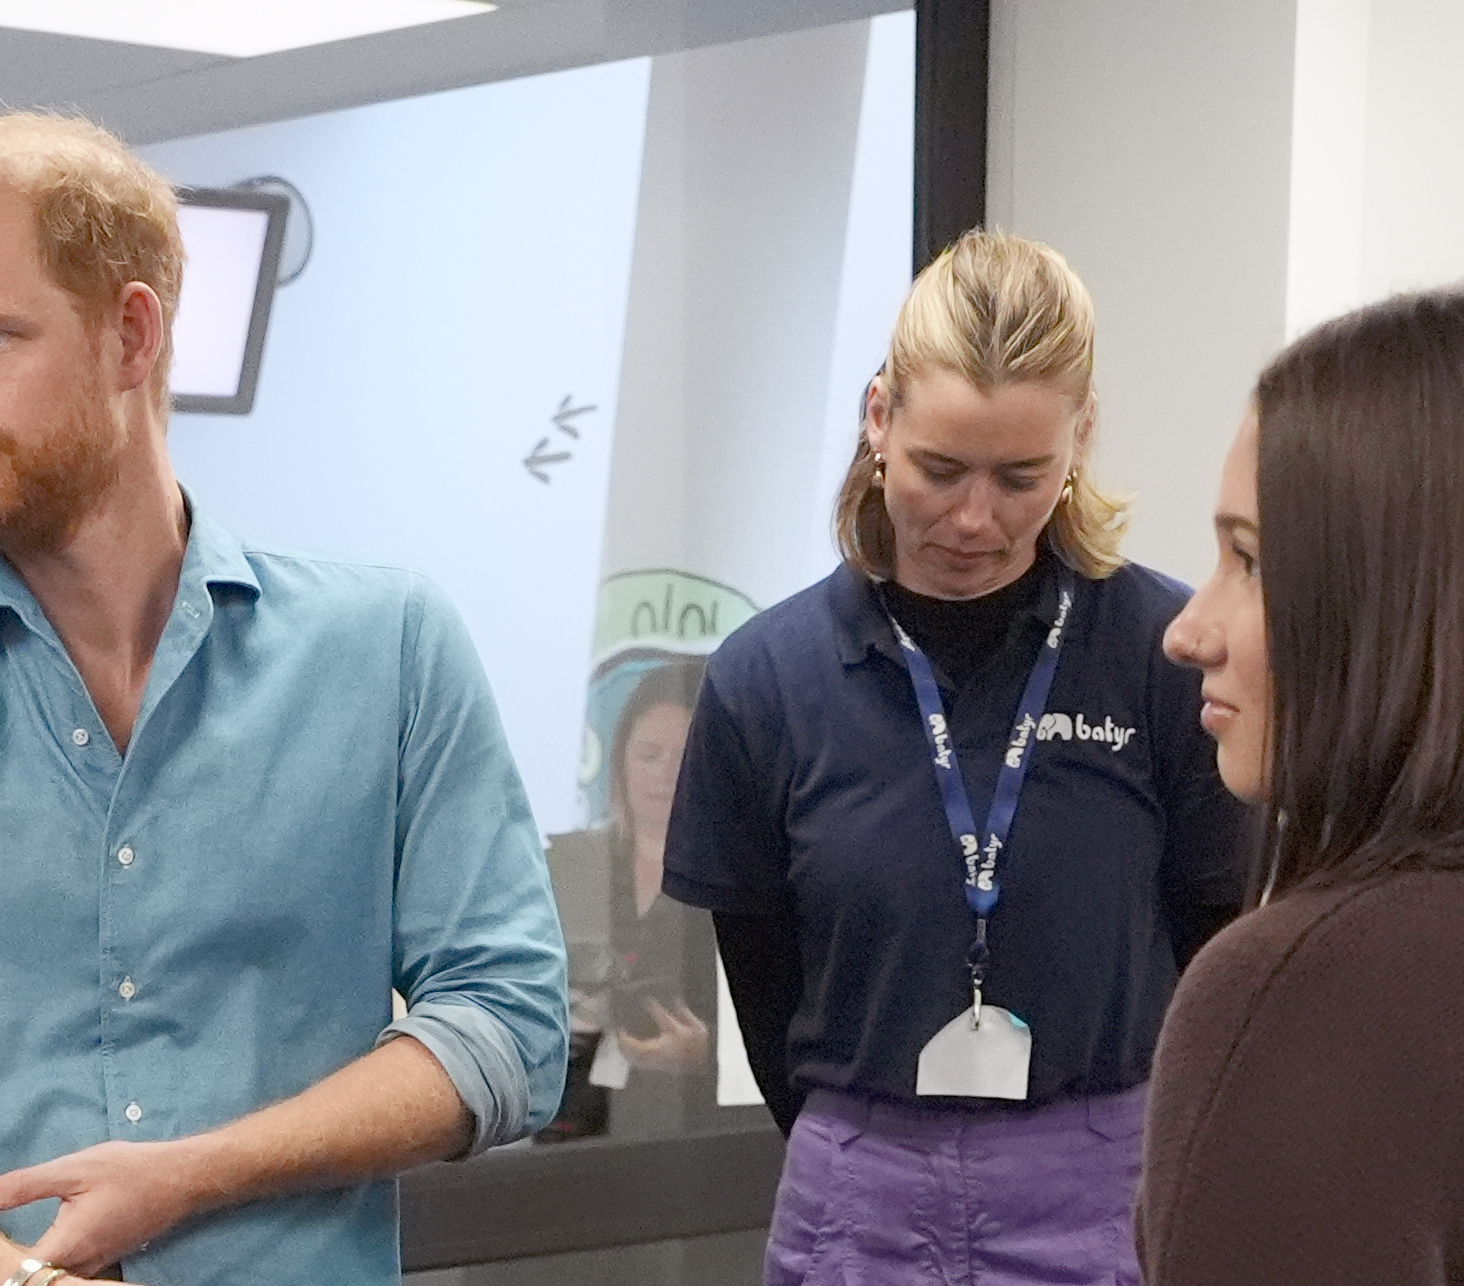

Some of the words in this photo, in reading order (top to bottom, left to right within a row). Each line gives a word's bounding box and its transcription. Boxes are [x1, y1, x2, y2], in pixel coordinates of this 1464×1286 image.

[1010, 713, 1036, 747] batyr
[1075, 714, 1136, 751] batyr
[934, 734, 953, 770] batyr
[980, 833, 1003, 869] batyr
